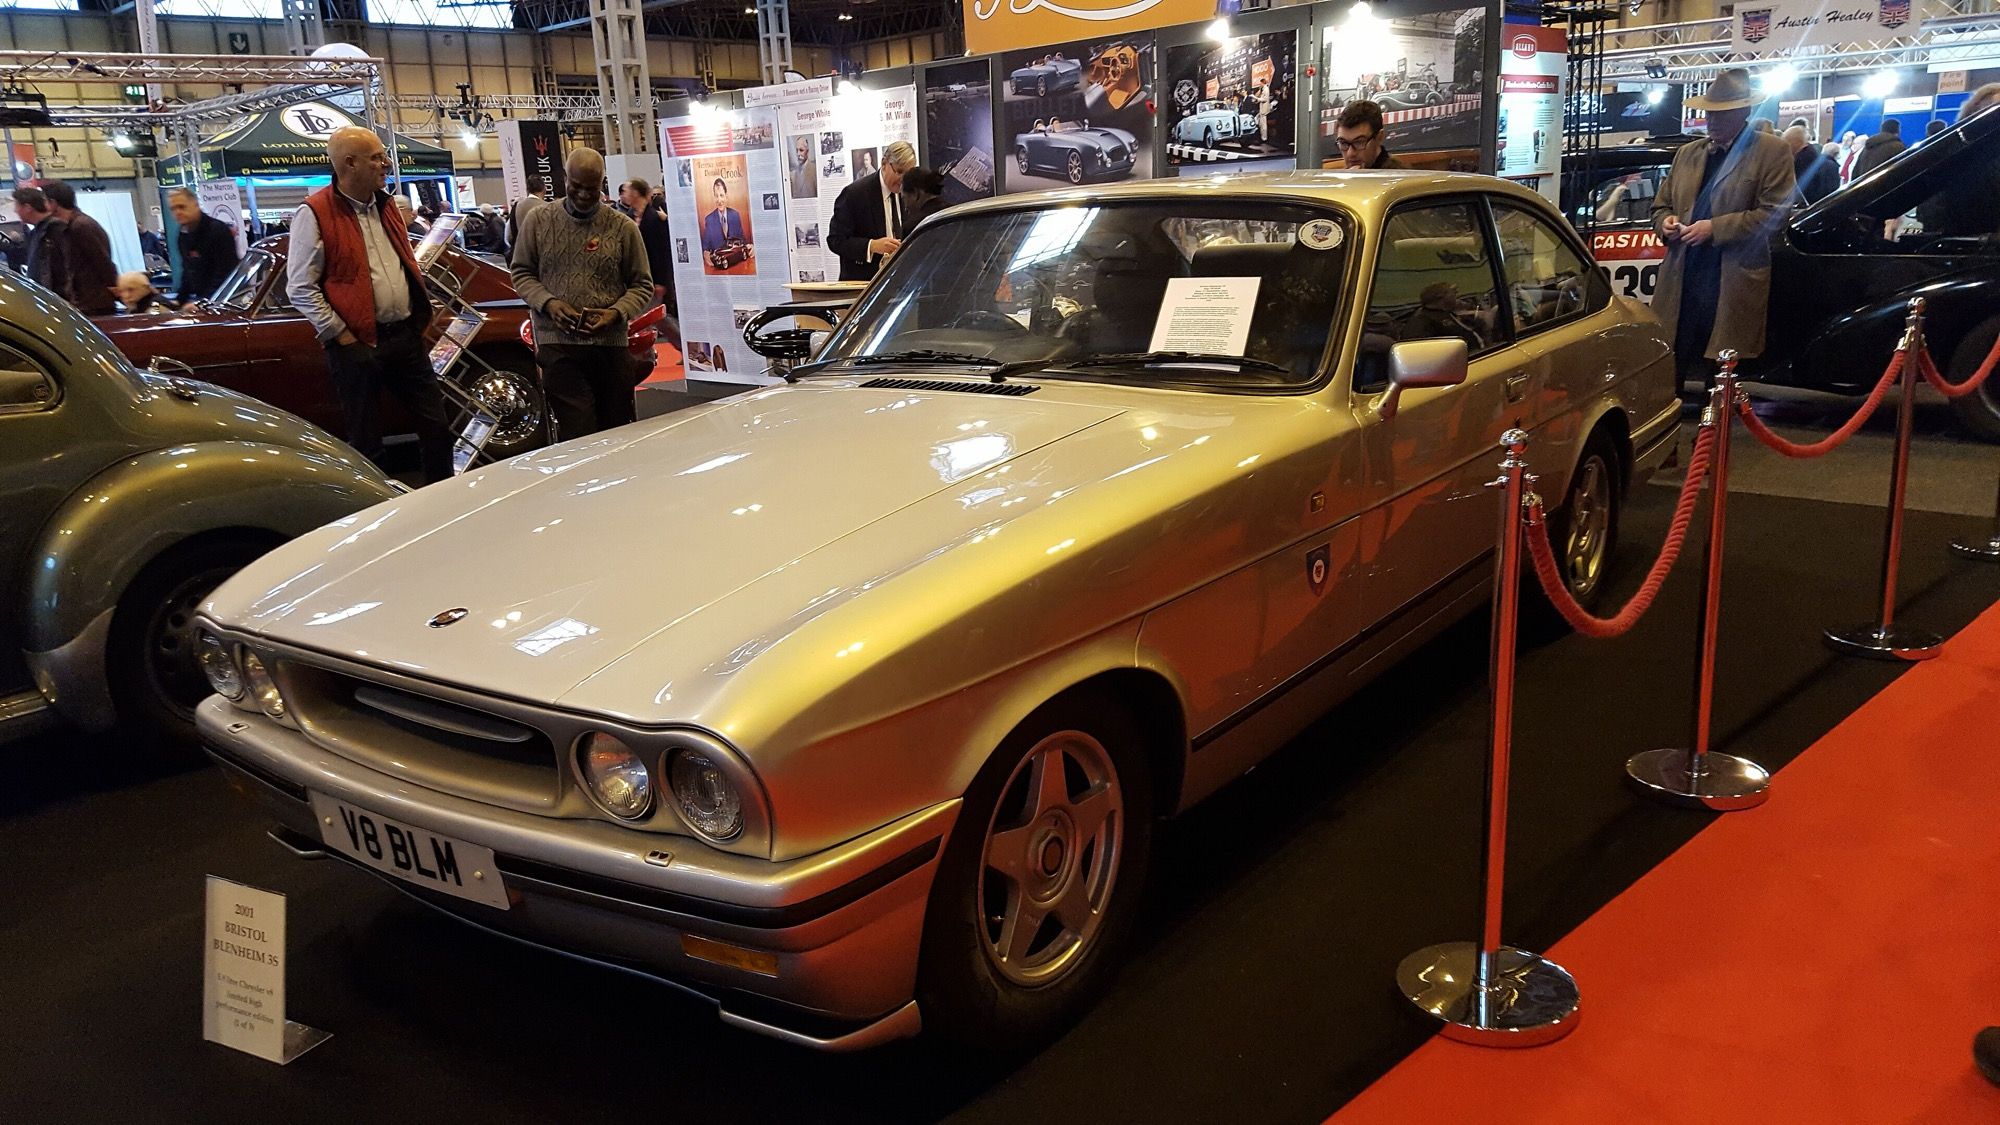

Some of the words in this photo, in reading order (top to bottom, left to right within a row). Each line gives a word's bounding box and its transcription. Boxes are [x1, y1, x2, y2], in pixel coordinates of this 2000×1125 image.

[1775, 16, 1820, 29] Austin
[1826, 9, 1873, 23] Healey
[885, 100, 904, 109] George
[797, 112, 814, 120] George
[815, 110, 831, 118] White
[894, 110, 911, 120] White
[537, 156, 551, 173] UK
[721, 165, 744, 179] Crook
[224, 192, 238, 201] Club
[338, 806, 384, 861] V8
[393, 823, 463, 887] BLM
[235, 904, 253, 919] 2001
[225, 921, 268, 943] BRISTOL
[213, 938, 265, 964] BLENHEIM
